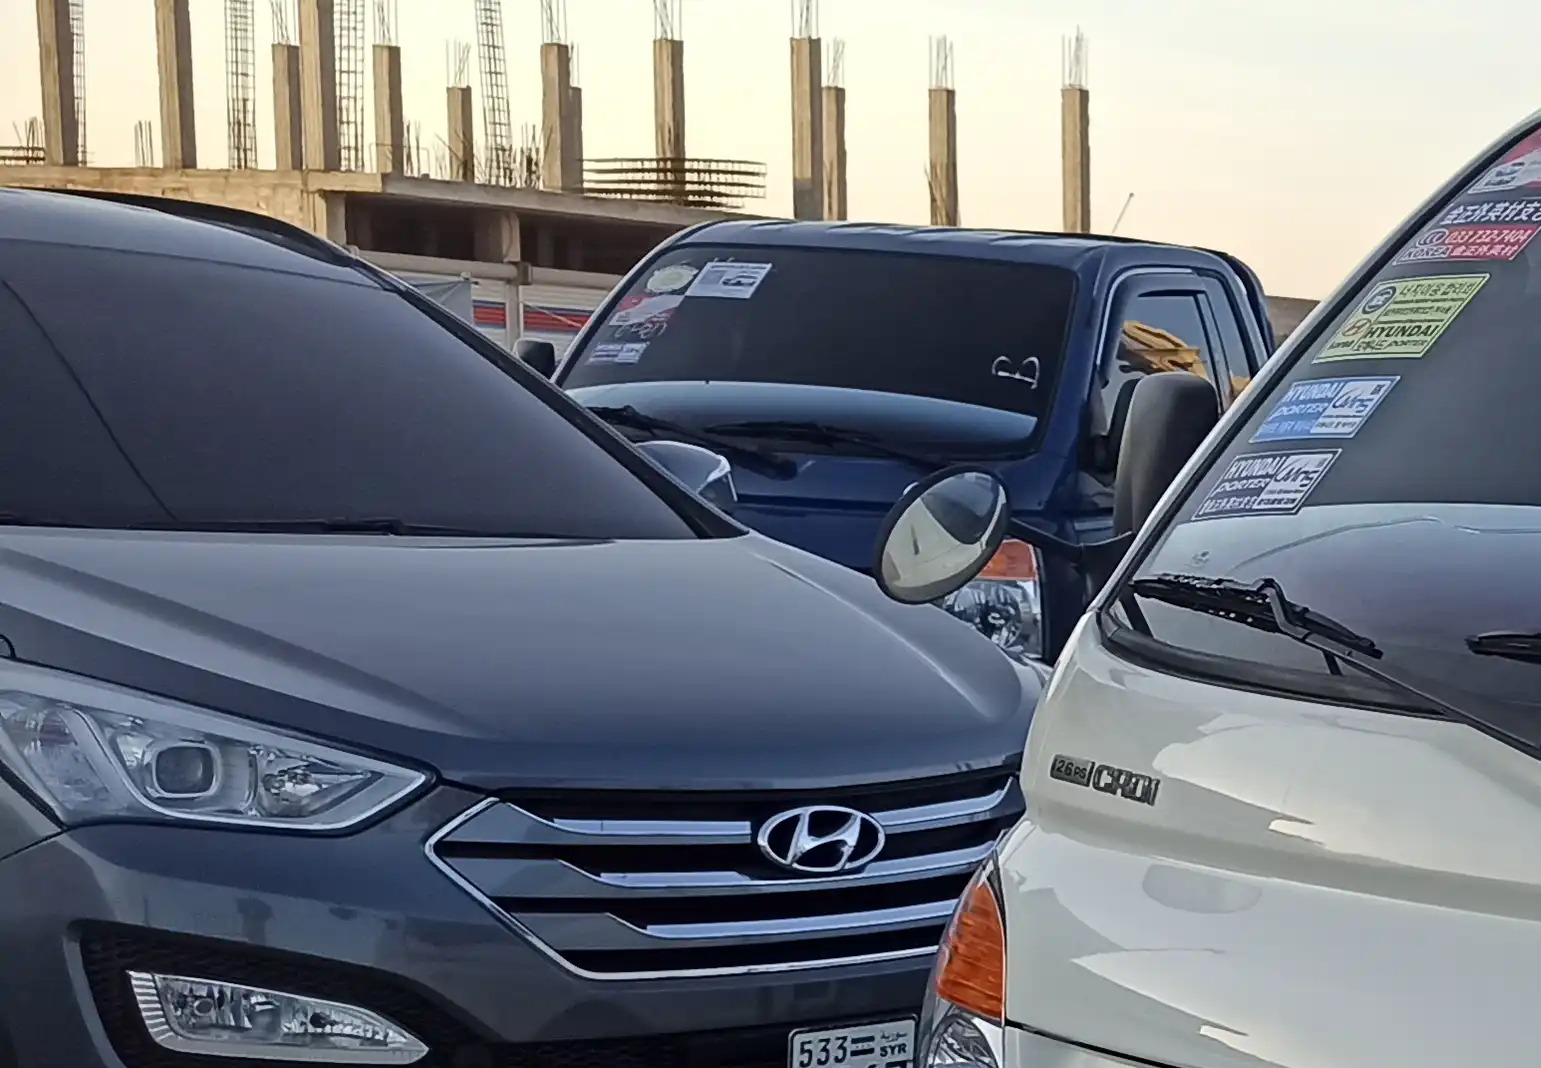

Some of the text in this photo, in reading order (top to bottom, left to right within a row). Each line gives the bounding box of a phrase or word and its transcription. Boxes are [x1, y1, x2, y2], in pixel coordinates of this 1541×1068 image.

[1364, 325, 1440, 339] HYUNDAI
[1283, 382, 1344, 402] HYUNDAI
[1268, 402, 1330, 421] PORTER
[1223, 456, 1287, 480] HYUNDAI
[1210, 479, 1272, 497] PORTER
[798, 1035, 849, 1068] 533
[879, 1042, 908, 1058] SYR
